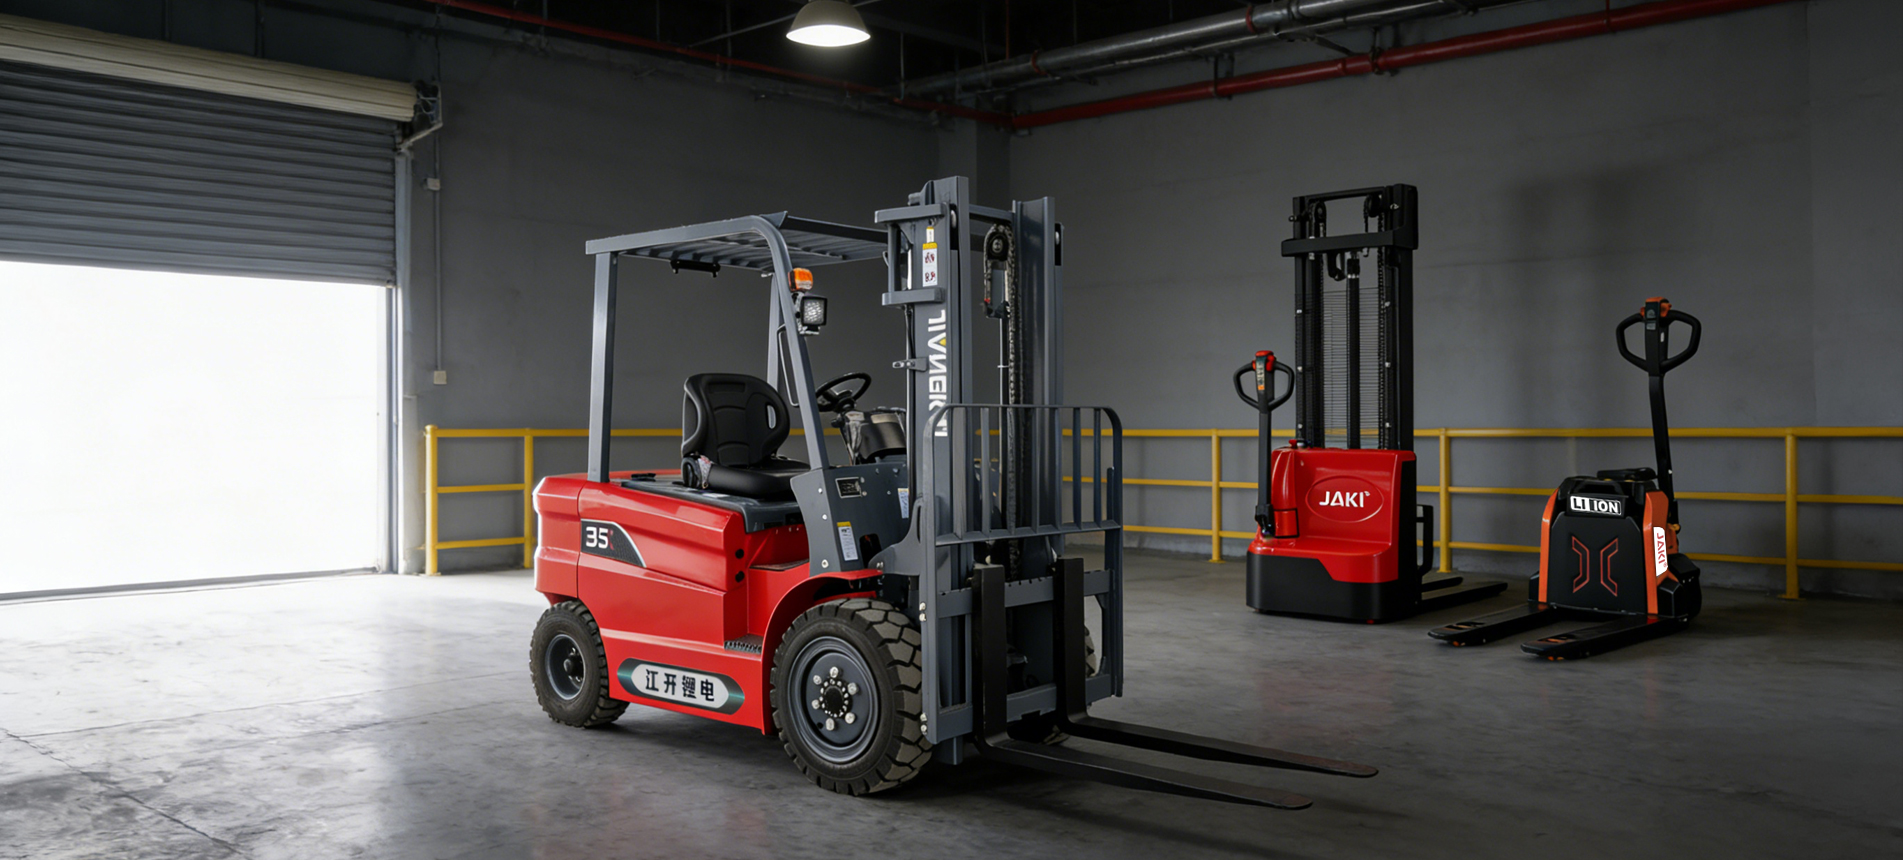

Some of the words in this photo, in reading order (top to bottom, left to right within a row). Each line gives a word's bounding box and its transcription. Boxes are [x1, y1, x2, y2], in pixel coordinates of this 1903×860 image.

[1572, 497, 1587, 510] LI
[1593, 500, 1618, 513] ION
[645, 669, 715, 702] 江开锂电
